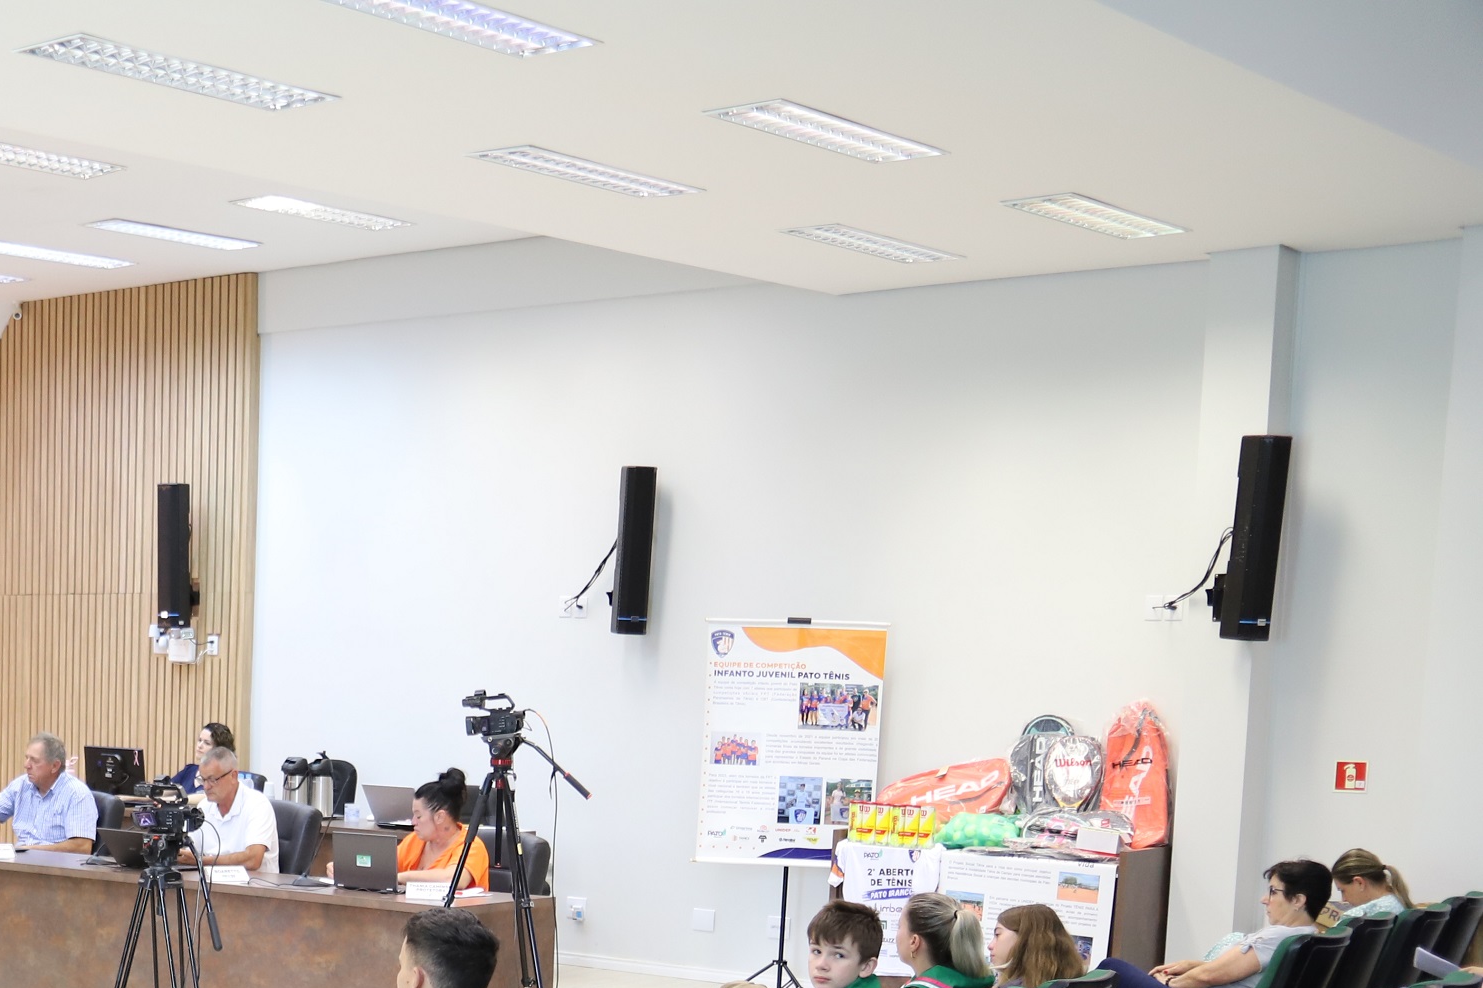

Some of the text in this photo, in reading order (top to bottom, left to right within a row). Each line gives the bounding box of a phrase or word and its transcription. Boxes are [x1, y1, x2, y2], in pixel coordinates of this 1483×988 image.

[756, 660, 807, 670] COMPETIÇÃO
[714, 670, 850, 680] INFANTO JUVENIL PATO TÊNIS
[1055, 757, 1093, 768] Wilson
[1112, 757, 1152, 770] HEAD
[1032, 737, 1048, 803] HEAD
[910, 770, 1000, 806] HEAD
[870, 877, 913, 887] DE TÊNIS
[870, 890, 887, 900] PATO
